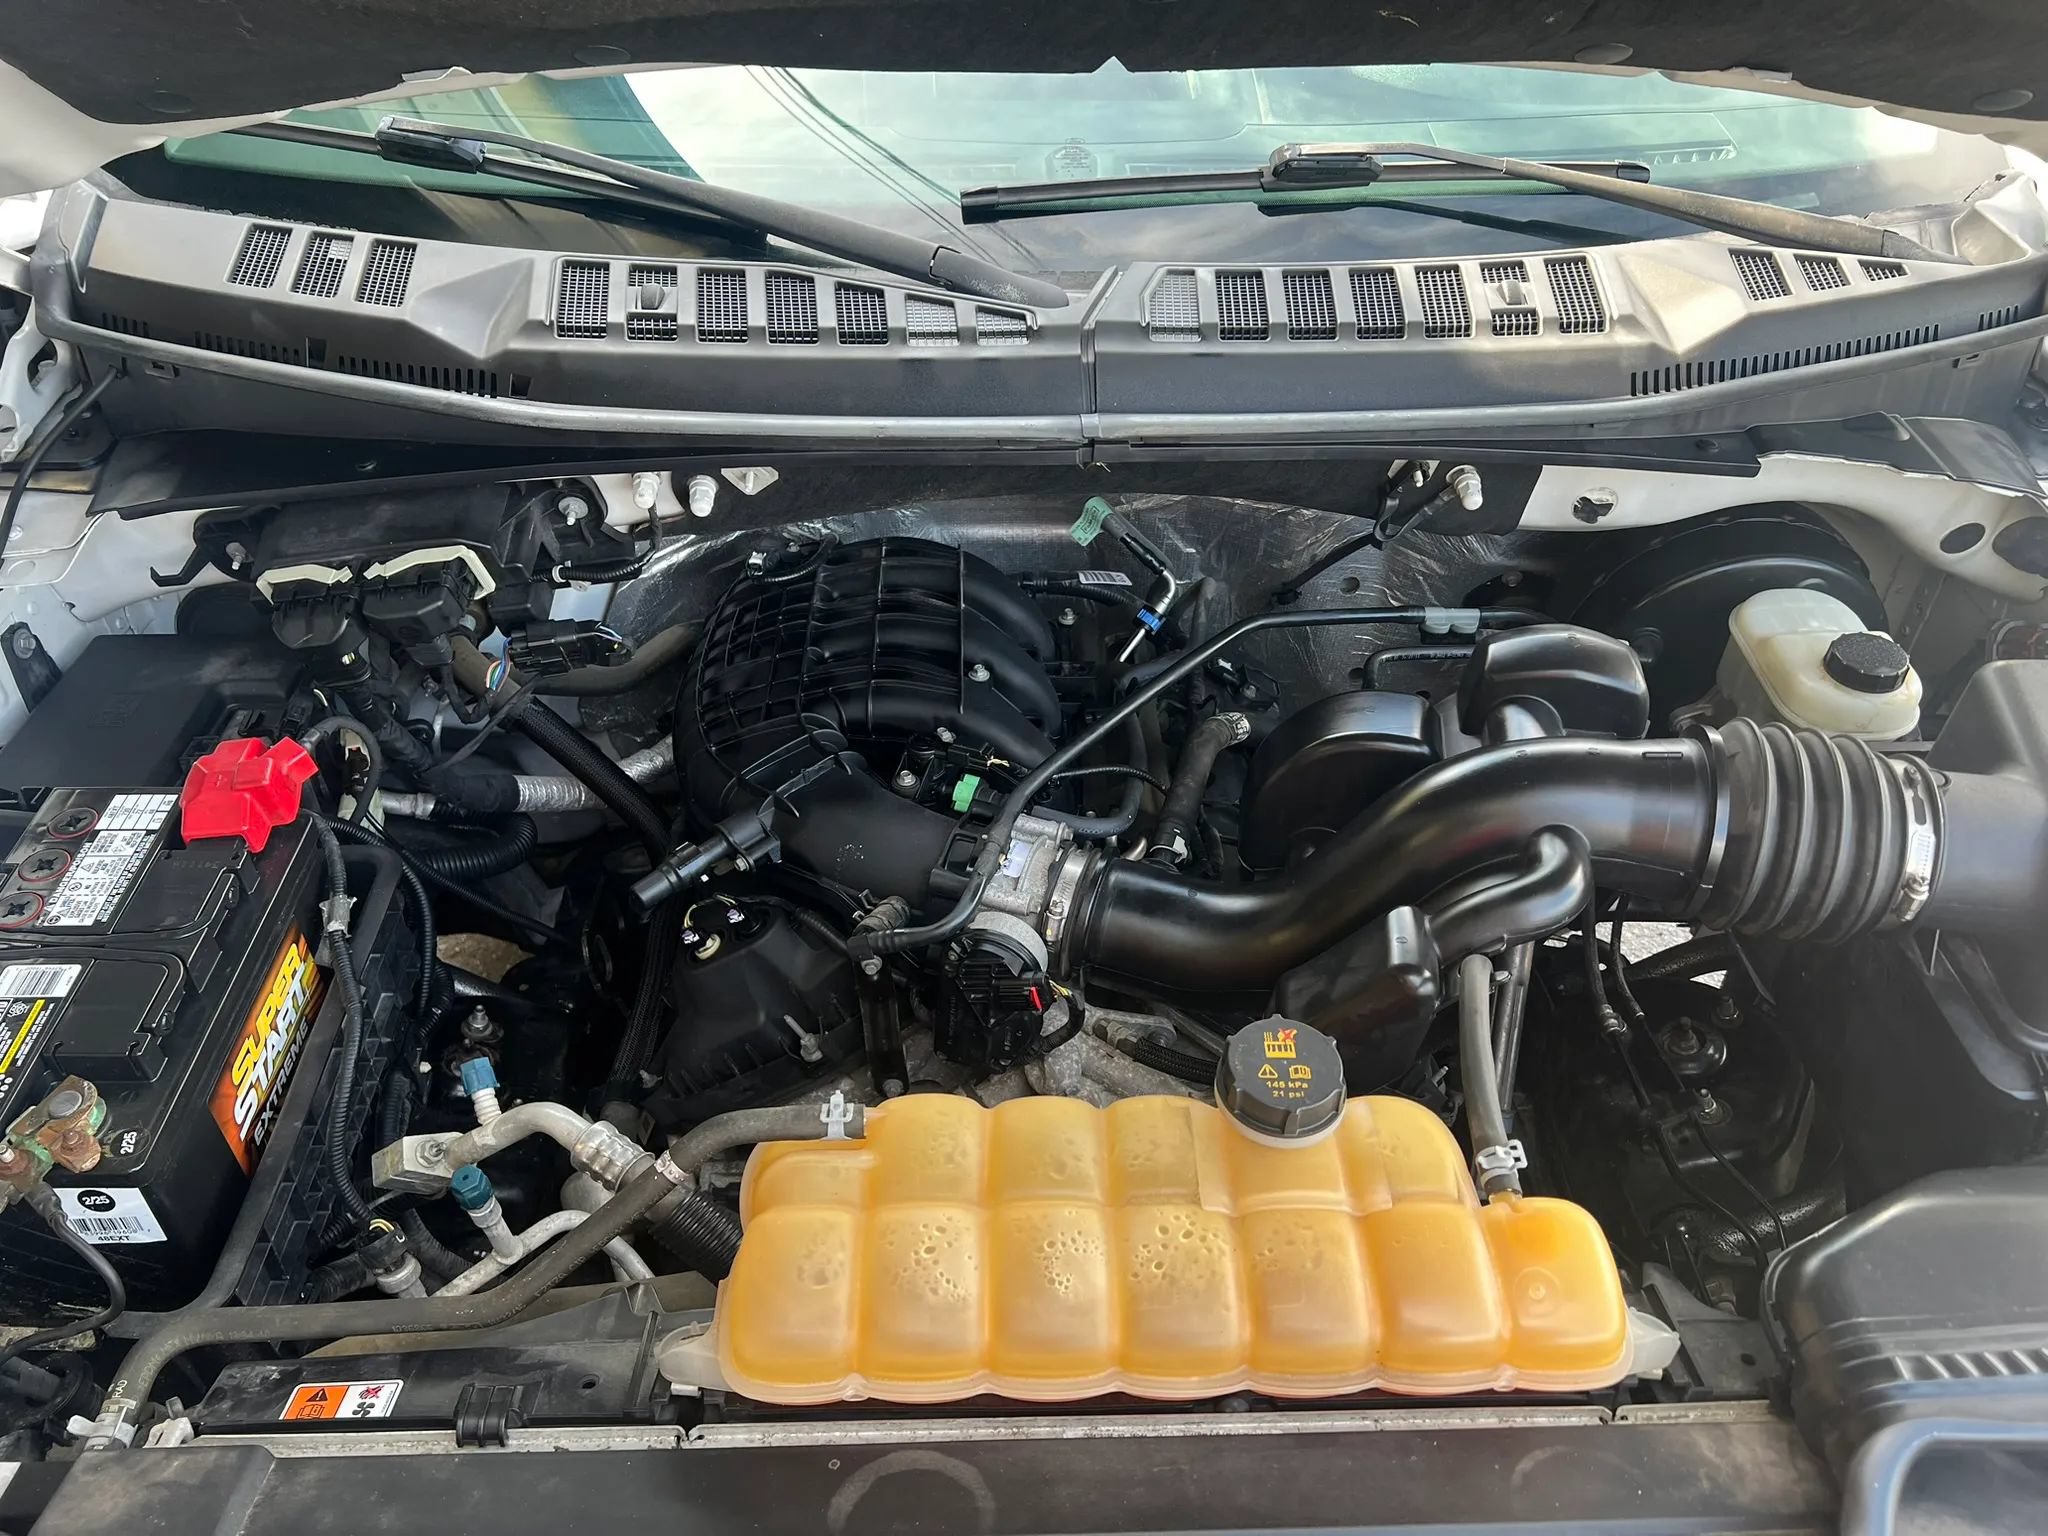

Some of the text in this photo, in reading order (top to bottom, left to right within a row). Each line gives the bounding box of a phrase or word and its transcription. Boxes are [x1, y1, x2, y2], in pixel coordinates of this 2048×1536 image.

[231, 943, 300, 1086] SUPER
[234, 961, 306, 1142] START
[254, 1016, 308, 1146] EXTREME
[1288, 1081, 1309, 1089] kPa
[1288, 1091, 1305, 1099] psi
[120, 1131, 137, 1155] 2/25
[82, 1195, 110, 1206] 2/25
[112, 1379, 128, 1398] RAD
